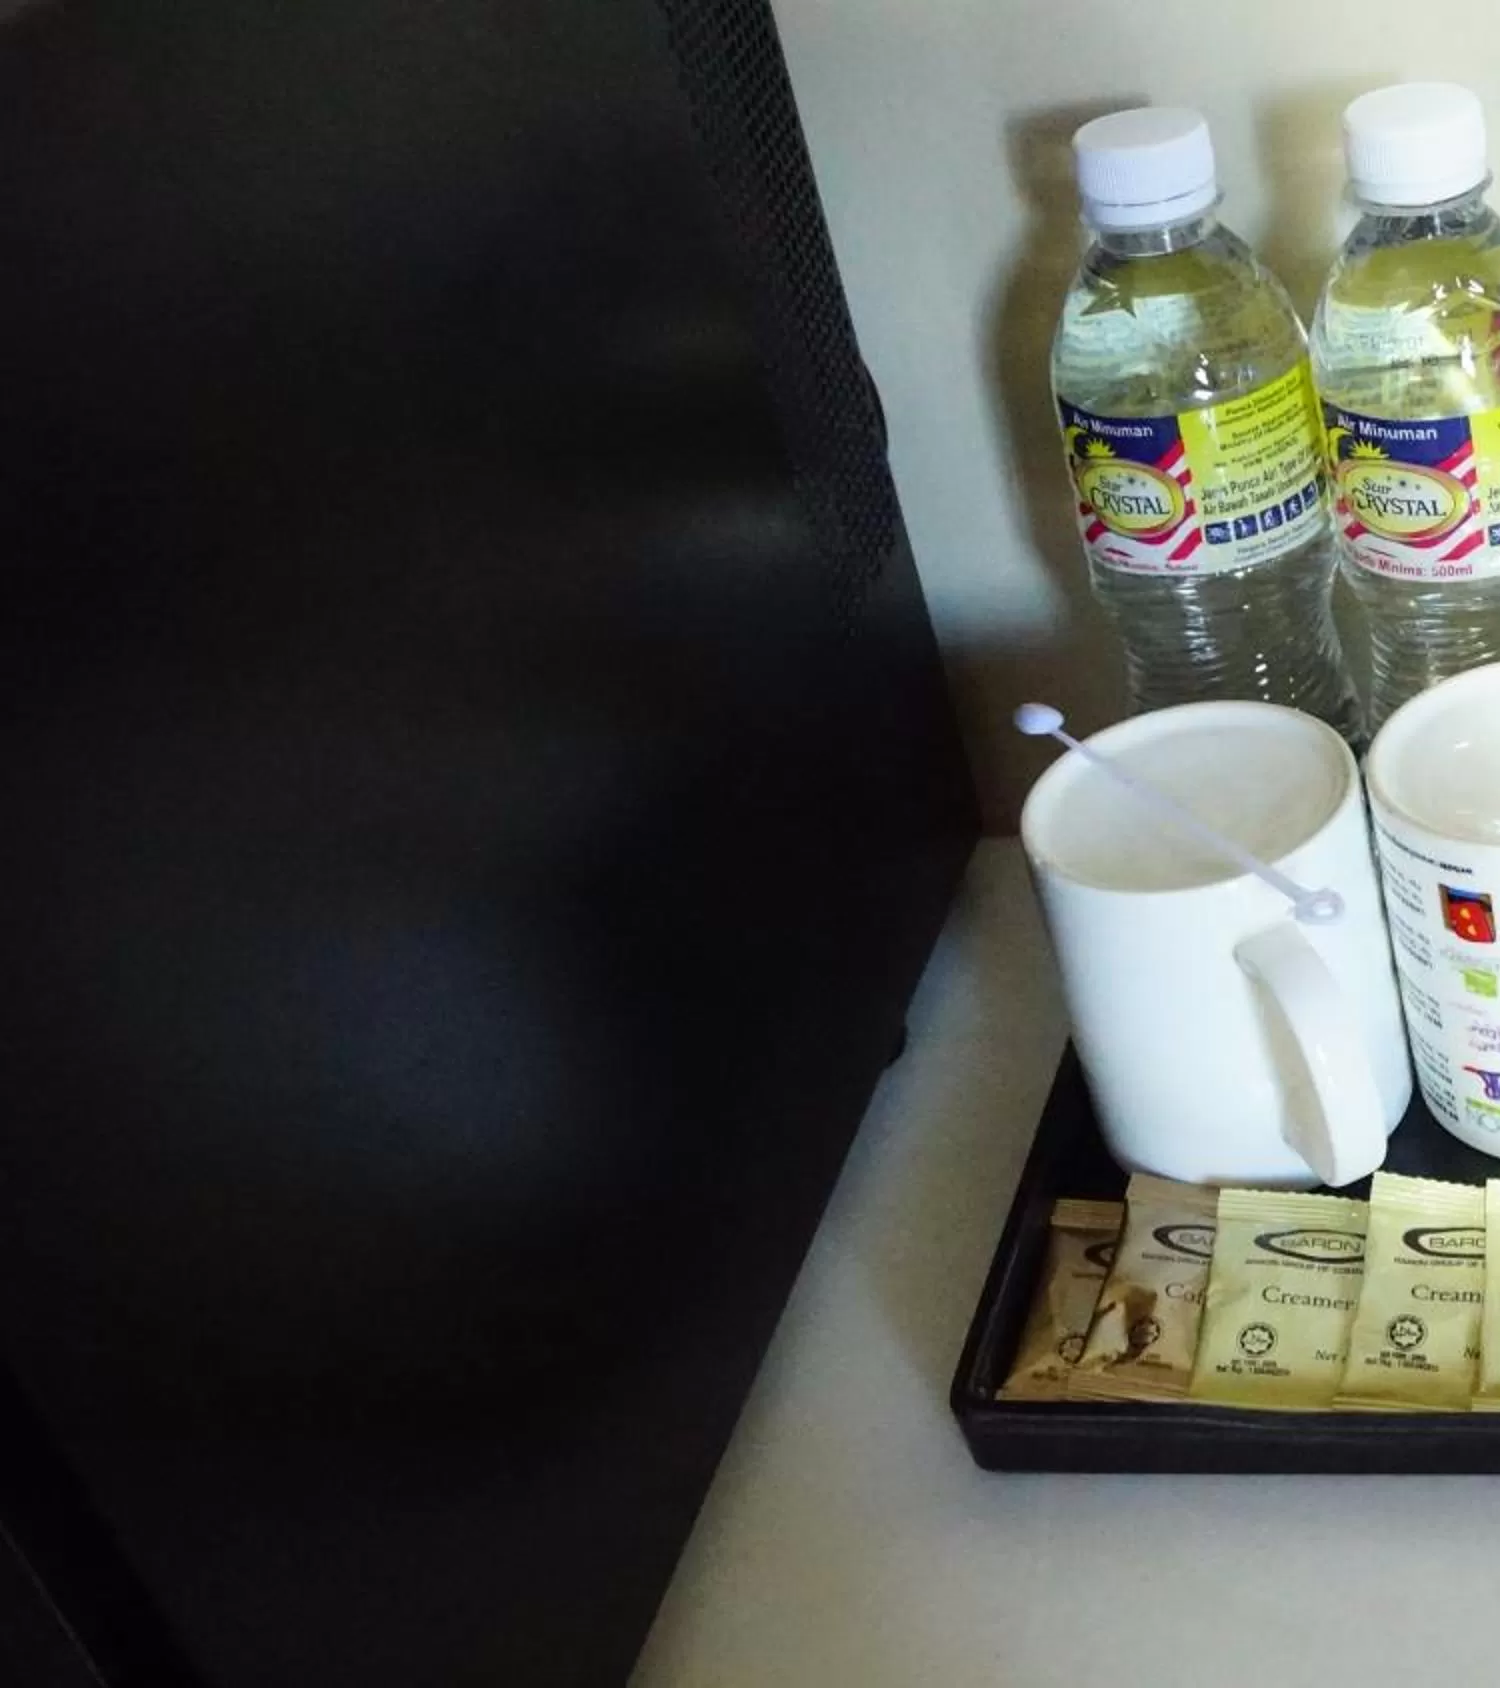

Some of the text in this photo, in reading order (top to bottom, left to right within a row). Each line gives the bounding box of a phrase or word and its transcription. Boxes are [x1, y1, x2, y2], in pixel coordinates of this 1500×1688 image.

[1090, 419, 1154, 438] Minuman
[1336, 413, 1438, 441] Air Minuman
[1090, 486, 1170, 517] CRYSTAL
[1351, 486, 1447, 518] CRYSTAL
[1280, 1237, 1362, 1253] BARON
[1428, 1237, 1486, 1249] BARO
[1165, 1281, 1206, 1305] Cof
[1261, 1284, 1355, 1311] Creamer
[1411, 1283, 1484, 1304] Cream
